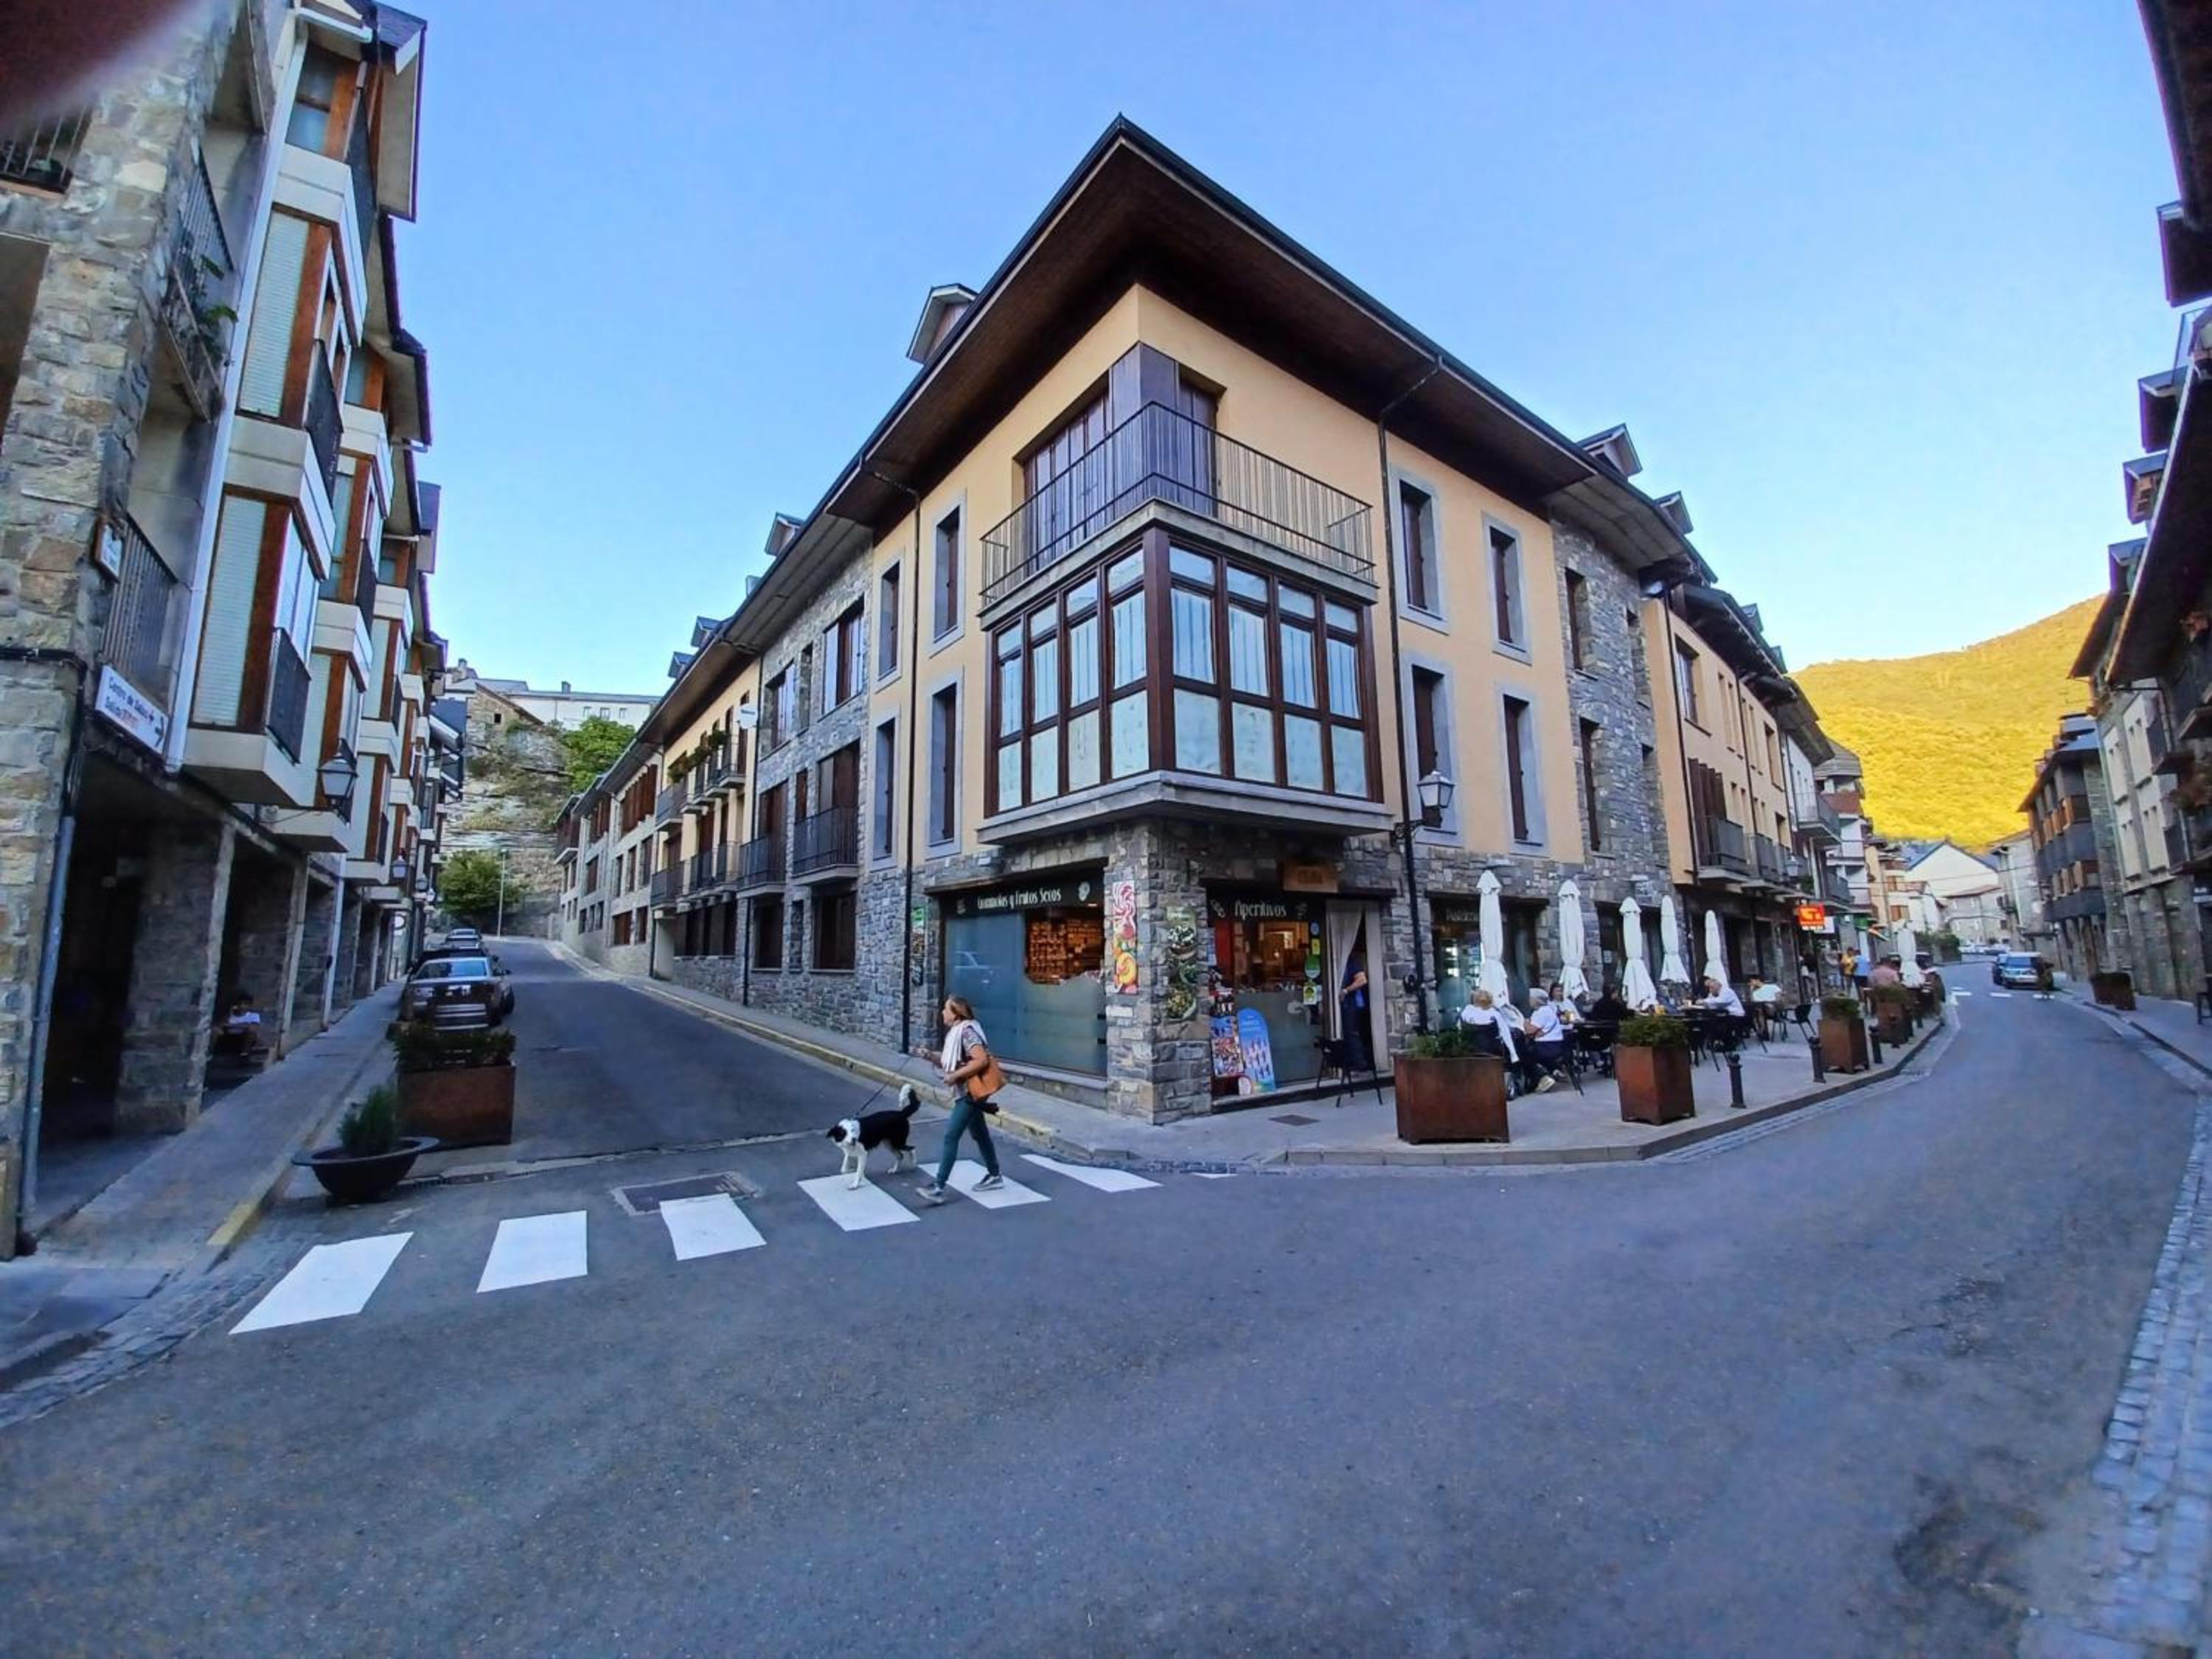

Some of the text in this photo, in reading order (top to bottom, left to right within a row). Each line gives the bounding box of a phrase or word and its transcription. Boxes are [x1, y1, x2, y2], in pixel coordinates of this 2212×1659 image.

[1015, 890, 1038, 905] Frutos
[1040, 887, 1061, 903] Secos
[1235, 899, 1287, 920] Aperitivos
